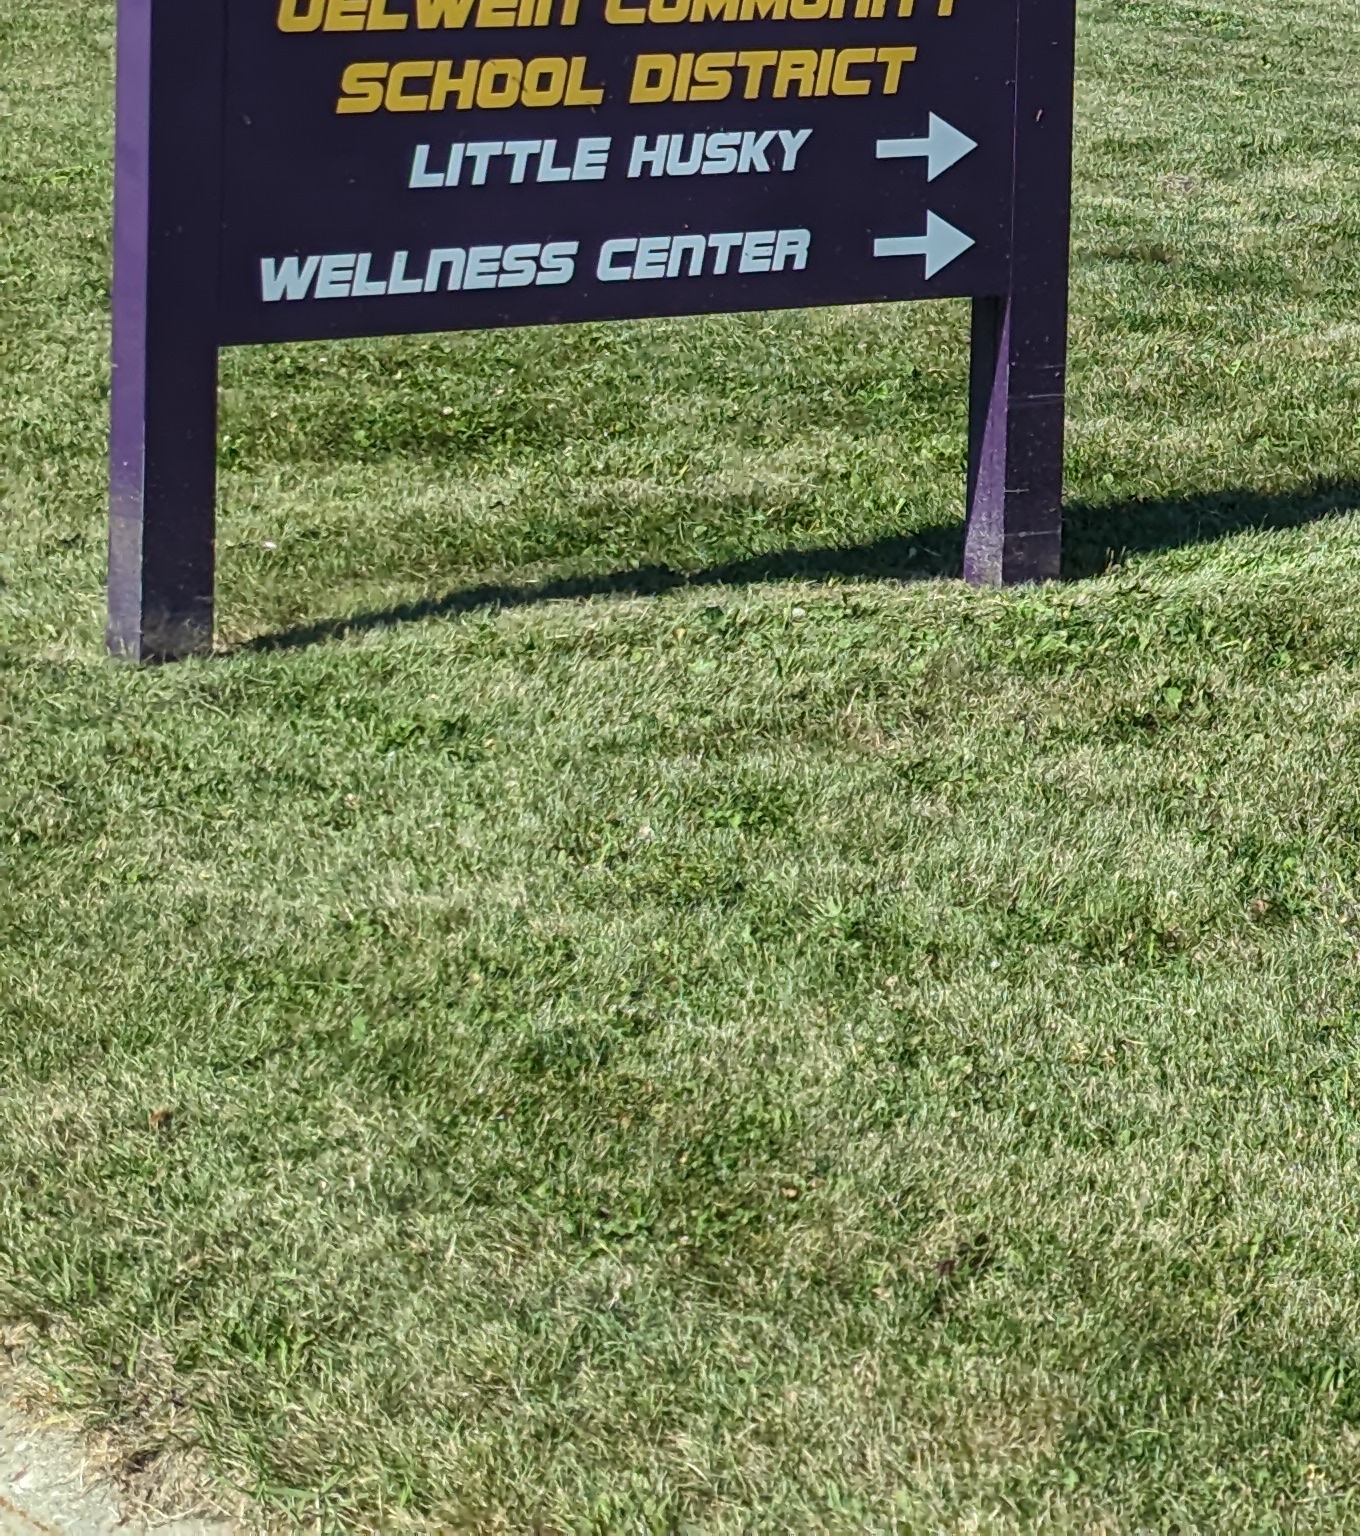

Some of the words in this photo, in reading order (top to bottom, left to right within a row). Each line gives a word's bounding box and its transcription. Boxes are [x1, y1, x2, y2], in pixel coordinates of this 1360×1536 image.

[336, 57, 602, 114] SCHOOL
[629, 47, 916, 104] DISTRICT
[409, 137, 611, 189] LITTLE
[626, 130, 812, 179] HUSKY
[260, 242, 578, 302] WELLNESS
[596, 229, 810, 282] CENTER
